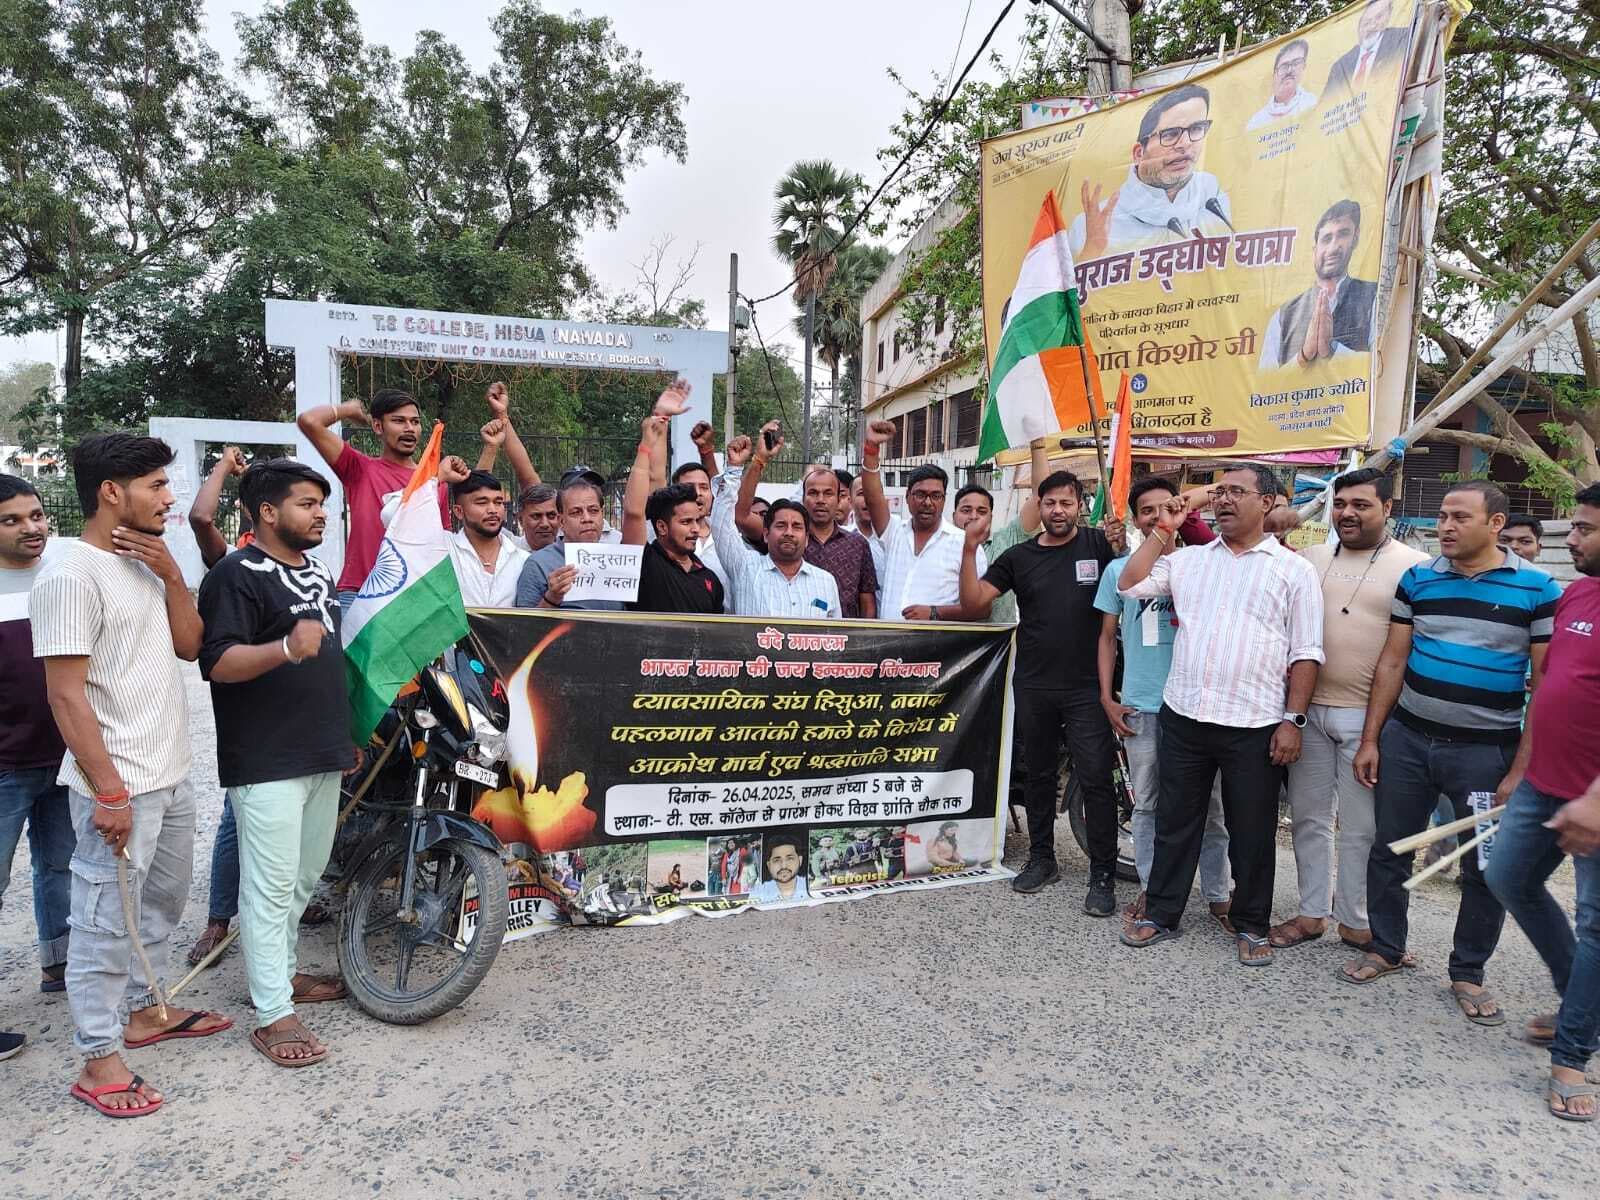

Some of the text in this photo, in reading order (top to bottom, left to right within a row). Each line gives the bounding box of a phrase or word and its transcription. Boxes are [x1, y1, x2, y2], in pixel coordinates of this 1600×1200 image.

[1235, 229, 1296, 265] यात्रा
[1109, 309, 1120, 320] के
[1122, 308, 1153, 320] नायक
[1156, 301, 1184, 315] बिहार
[1197, 293, 1240, 307] व्यवस्था
[404, 316, 489, 341] COLLEGE,
[495, 323, 545, 343] HISUA
[552, 327, 633, 349] (NAWADA)
[1099, 318, 1190, 339] परिवर्तन के सूत्रधार
[441, 343, 467, 356] UNIT
[472, 345, 486, 357] OF
[541, 350, 602, 363] UNIVERSITY
[1137, 334, 1221, 368] किशोर
[1225, 327, 1257, 356] जी
[1134, 395, 1195, 409] आगमन पर
[1250, 377, 1367, 408] विकास कुमार ज्योति
[577, 549, 638, 570] हिन्दुस्तान
[603, 576, 638, 589] बदला
[757, 626, 785, 650] वंदे
[640, 655, 942, 680] भारत माता की जय इन्कलाब जिंदाबाद
[632, 689, 769, 710] व्यावसायिक
[772, 690, 812, 710] संघ
[814, 689, 884, 716] हिसुआ,
[611, 726, 717, 744] पहलगाम
[719, 720, 801, 742] आतंकी
[802, 720, 854, 742] हमले
[858, 719, 883, 739] के
[938, 712, 960, 733] में
[629, 752, 720, 776] आक्रोश
[721, 750, 771, 773] मार्च
[768, 751, 807, 777] एवं
[892, 747, 940, 763] सभा
[722, 785, 796, 804] 26.04.2025,
[801, 784, 834, 799] समय
[872, 778, 880, 793] 5
[884, 776, 906, 793] बजे
[911, 776, 924, 793] से
[667, 808, 683, 827] टी.
[689, 813, 714, 827] एस.
[719, 807, 759, 826] कॉलेज
[762, 805, 776, 822] से
[778, 801, 812, 820] प्रारंभ
[813, 800, 845, 819] होकर
[882, 796, 916, 817] शांति
[918, 796, 942, 812] चौक
[943, 796, 963, 809] तक
[927, 869, 991, 883] attack
